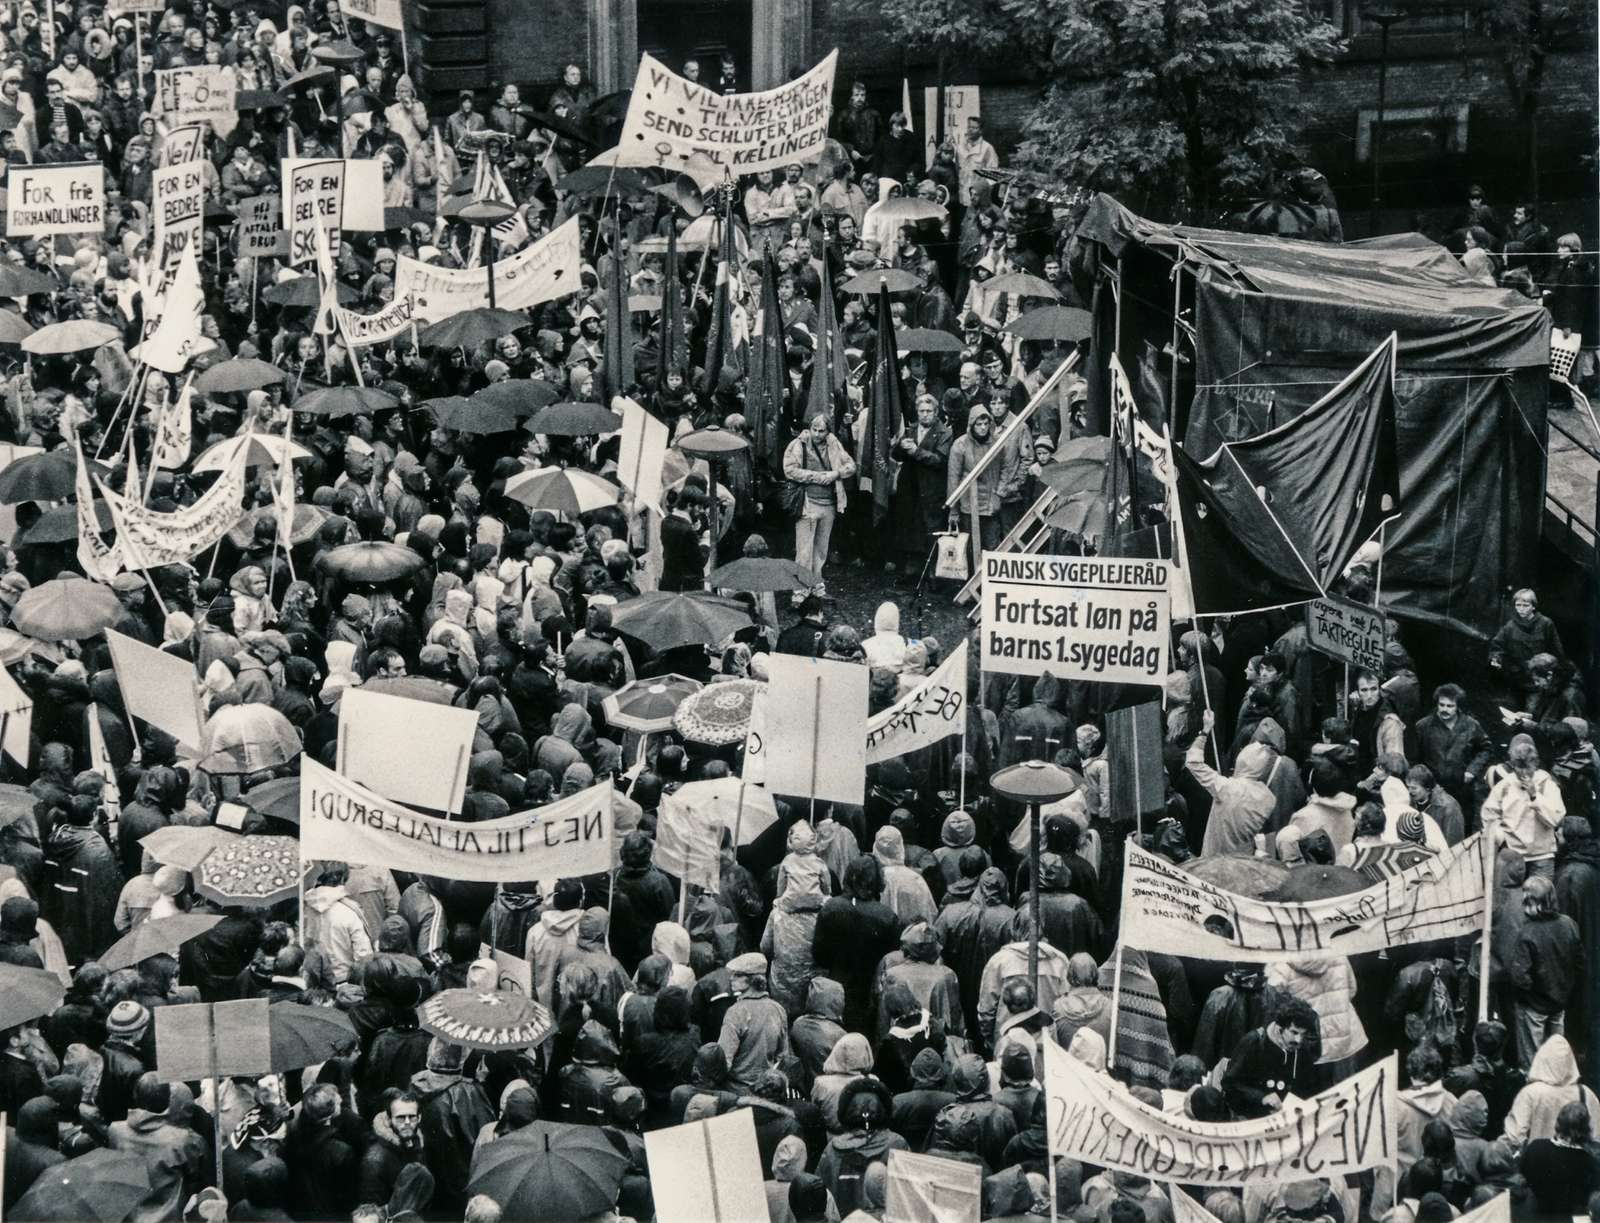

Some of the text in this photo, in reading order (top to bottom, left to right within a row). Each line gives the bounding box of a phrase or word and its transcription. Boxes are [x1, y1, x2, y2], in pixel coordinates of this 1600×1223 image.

[650, 68, 670, 94] VI
[683, 82, 719, 109] VIL
[643, 110, 693, 138] SEND
[699, 108, 733, 127] TIL
[733, 127, 828, 165] KÆLLINGEN
[22, 177, 94, 205] FOR frie
[158, 171, 200, 198] FOR EN
[294, 176, 339, 196] FOR EN
[13, 205, 101, 227] FORHANDLINGER
[164, 194, 200, 221] BEDRE
[249, 236, 276, 248] BRUD
[987, 558, 1046, 580] DANSK
[1049, 561, 1168, 586] SYGEPLEJERÅD
[994, 592, 1158, 637] Fortsat løn på
[989, 631, 1053, 661] barns
